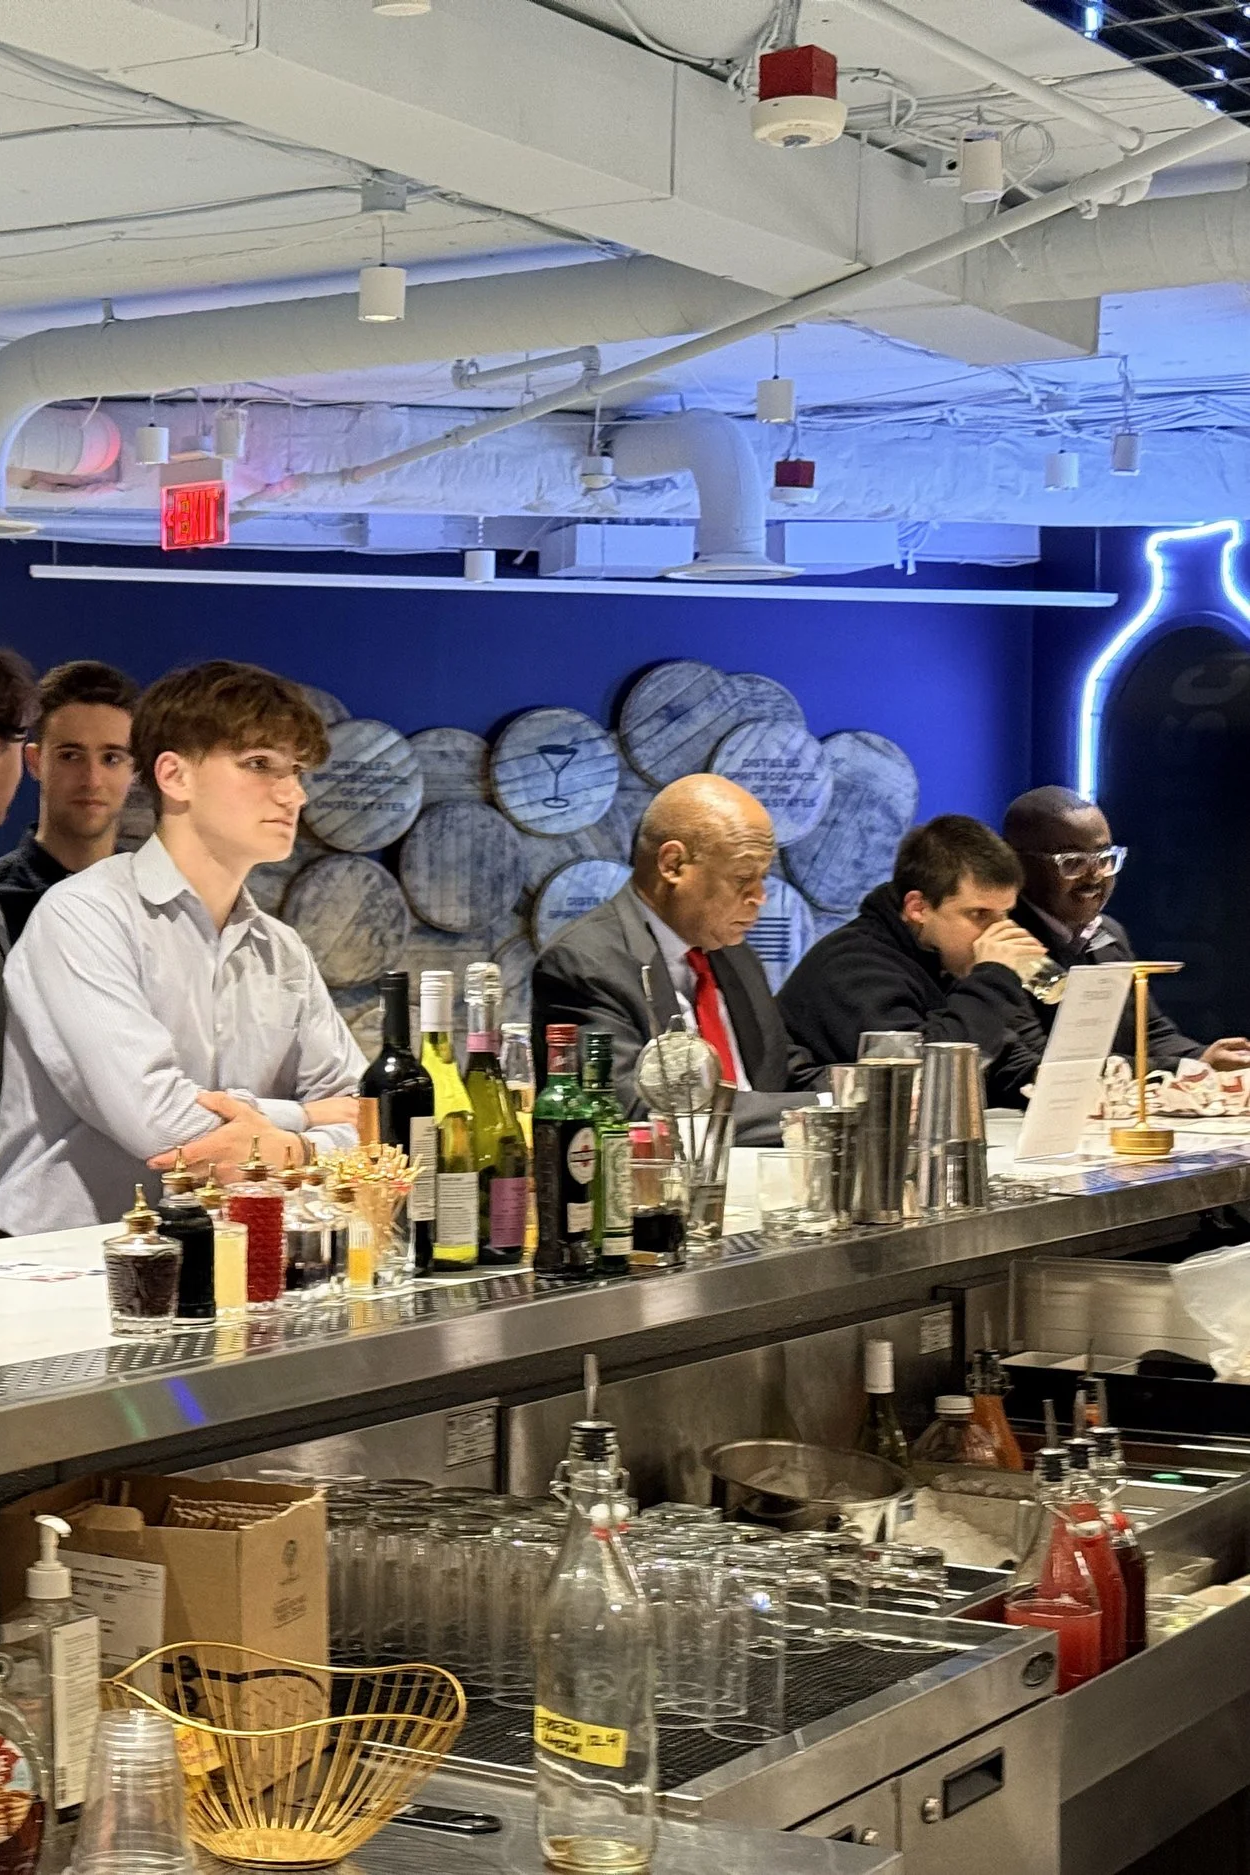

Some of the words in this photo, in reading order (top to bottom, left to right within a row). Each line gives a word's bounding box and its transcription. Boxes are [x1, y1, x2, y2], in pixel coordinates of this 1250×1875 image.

[174, 488, 220, 545] EXIT
[332, 761, 391, 771] DISTILLED
[742, 758, 799, 768] DISTILLED
[312, 773, 360, 783] SPIRITS
[362, 775, 410, 785] COUNCIL
[769, 771, 818, 781] COUNCIL
[316, 801, 358, 810] UNITED
[361, 802, 406, 812] STATES
